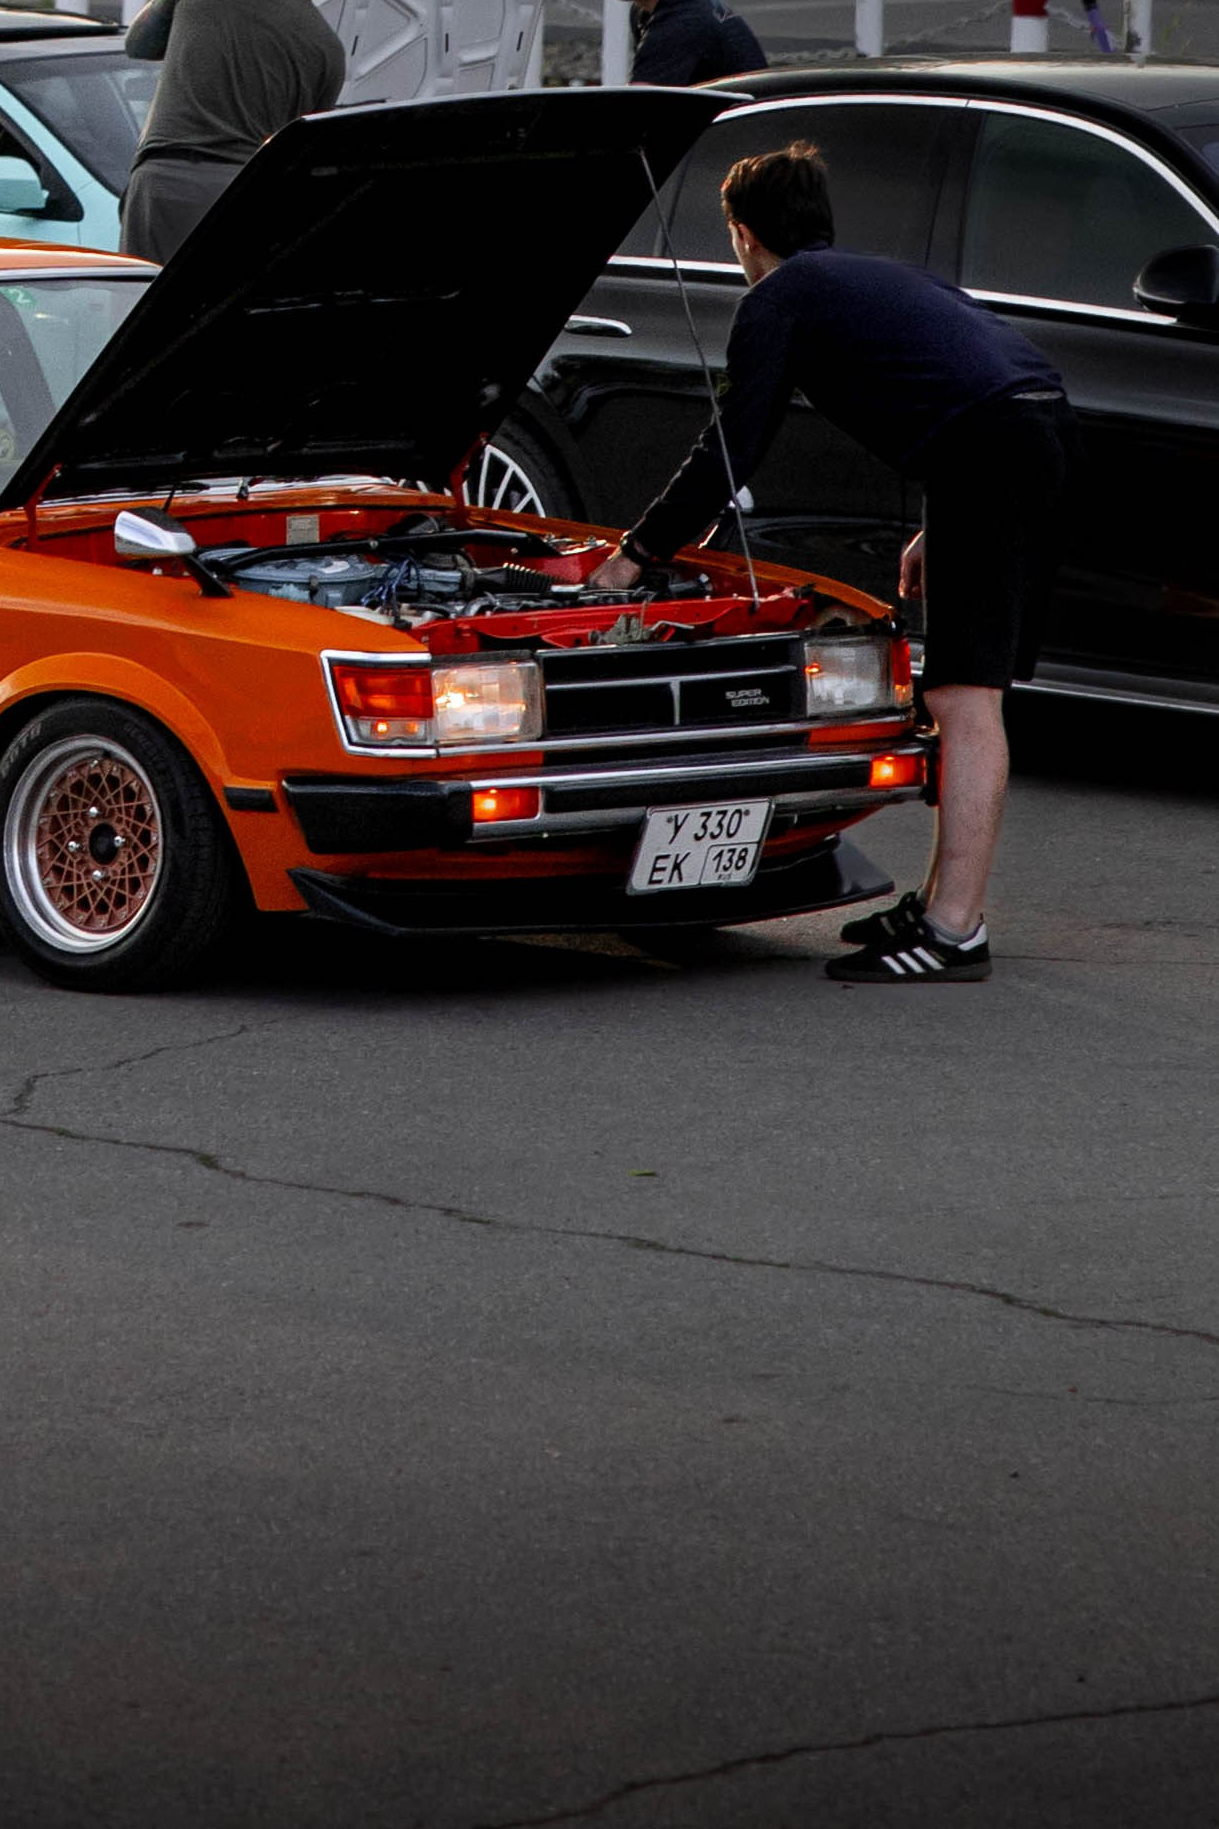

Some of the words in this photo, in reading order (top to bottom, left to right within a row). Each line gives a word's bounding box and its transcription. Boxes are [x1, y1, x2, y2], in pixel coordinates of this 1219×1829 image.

[725, 688, 762, 700] SUPER
[731, 696, 770, 708] EDITION
[693, 808, 744, 842] 330
[647, 852, 691, 885] ЕК
[711, 846, 749, 874] 138
